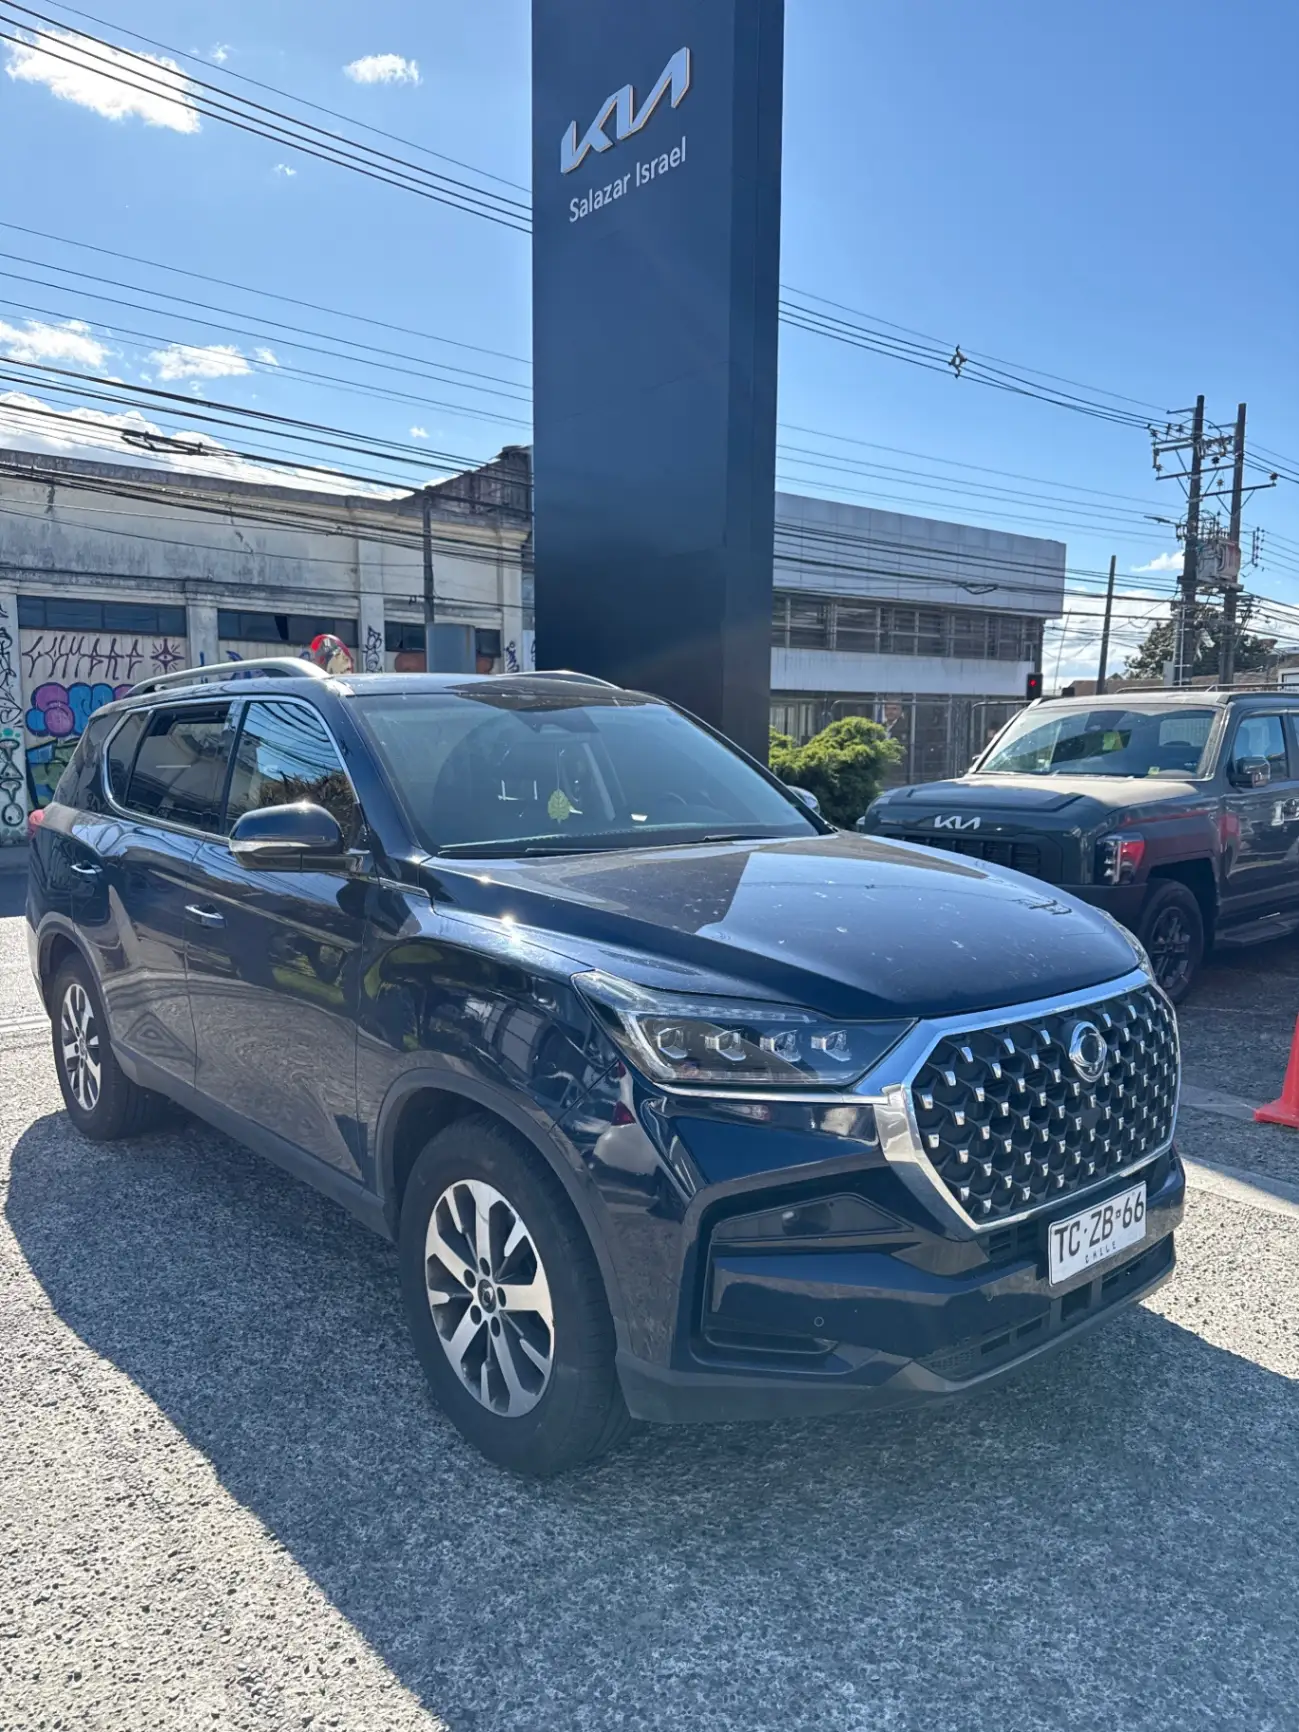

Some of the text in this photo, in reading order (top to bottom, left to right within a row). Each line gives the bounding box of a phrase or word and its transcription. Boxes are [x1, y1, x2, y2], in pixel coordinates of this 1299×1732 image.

[569, 135, 687, 223] Salazar Israel
[1085, 1240, 1117, 1264] CHILE
